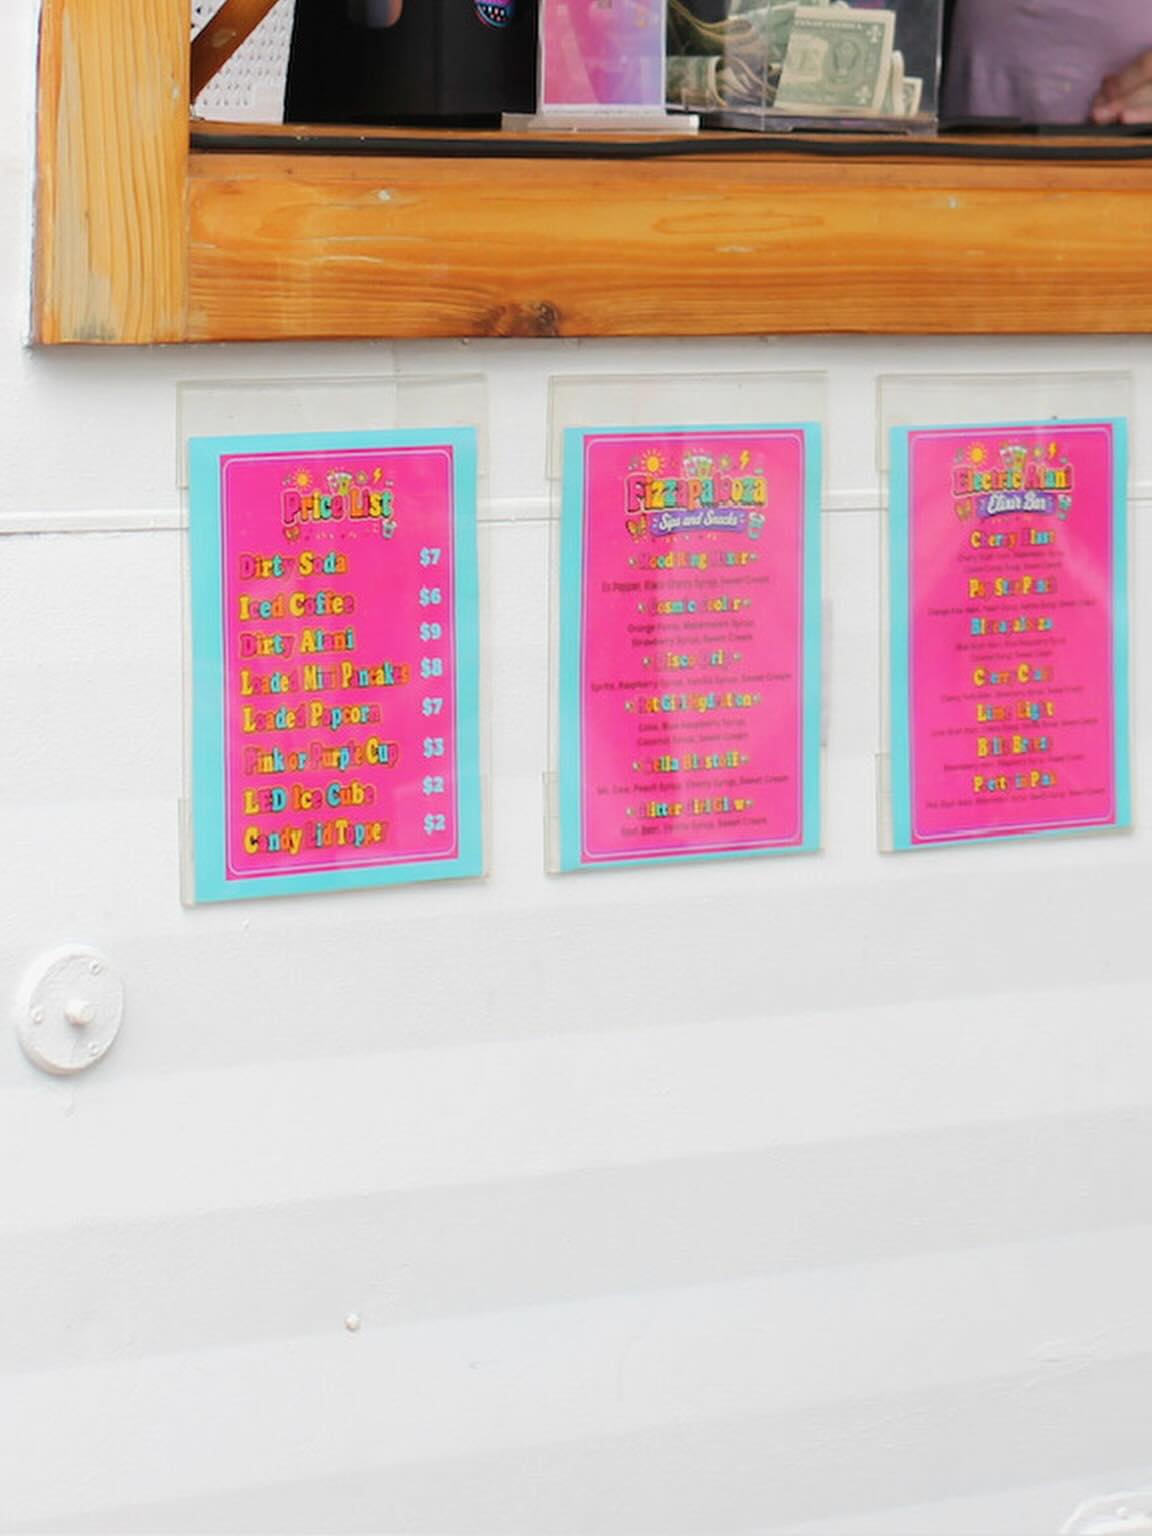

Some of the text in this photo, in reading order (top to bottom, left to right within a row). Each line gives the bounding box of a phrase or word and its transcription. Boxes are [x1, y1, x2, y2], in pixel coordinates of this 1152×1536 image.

[282, 487, 394, 524] Price List
[659, 510, 740, 531] Sips and Snacks
[239, 547, 441, 580] Dirty Soda $7
[639, 551, 673, 571] ood
[238, 585, 442, 621] Iced Coffee $6
[648, 597, 697, 616] osmc
[239, 621, 442, 659] Dirty Alani $9
[240, 667, 299, 697] Loaded
[420, 657, 443, 679] $8
[655, 650, 698, 671] isco
[241, 696, 444, 734] Loaded Popcorn $7
[243, 744, 286, 775] Pink
[286, 751, 310, 771] or
[364, 736, 400, 768] Cup
[422, 736, 445, 759] $3
[243, 775, 445, 816] LED Ice Cube $2
[243, 825, 304, 856] Candy
[423, 813, 447, 836] $2
